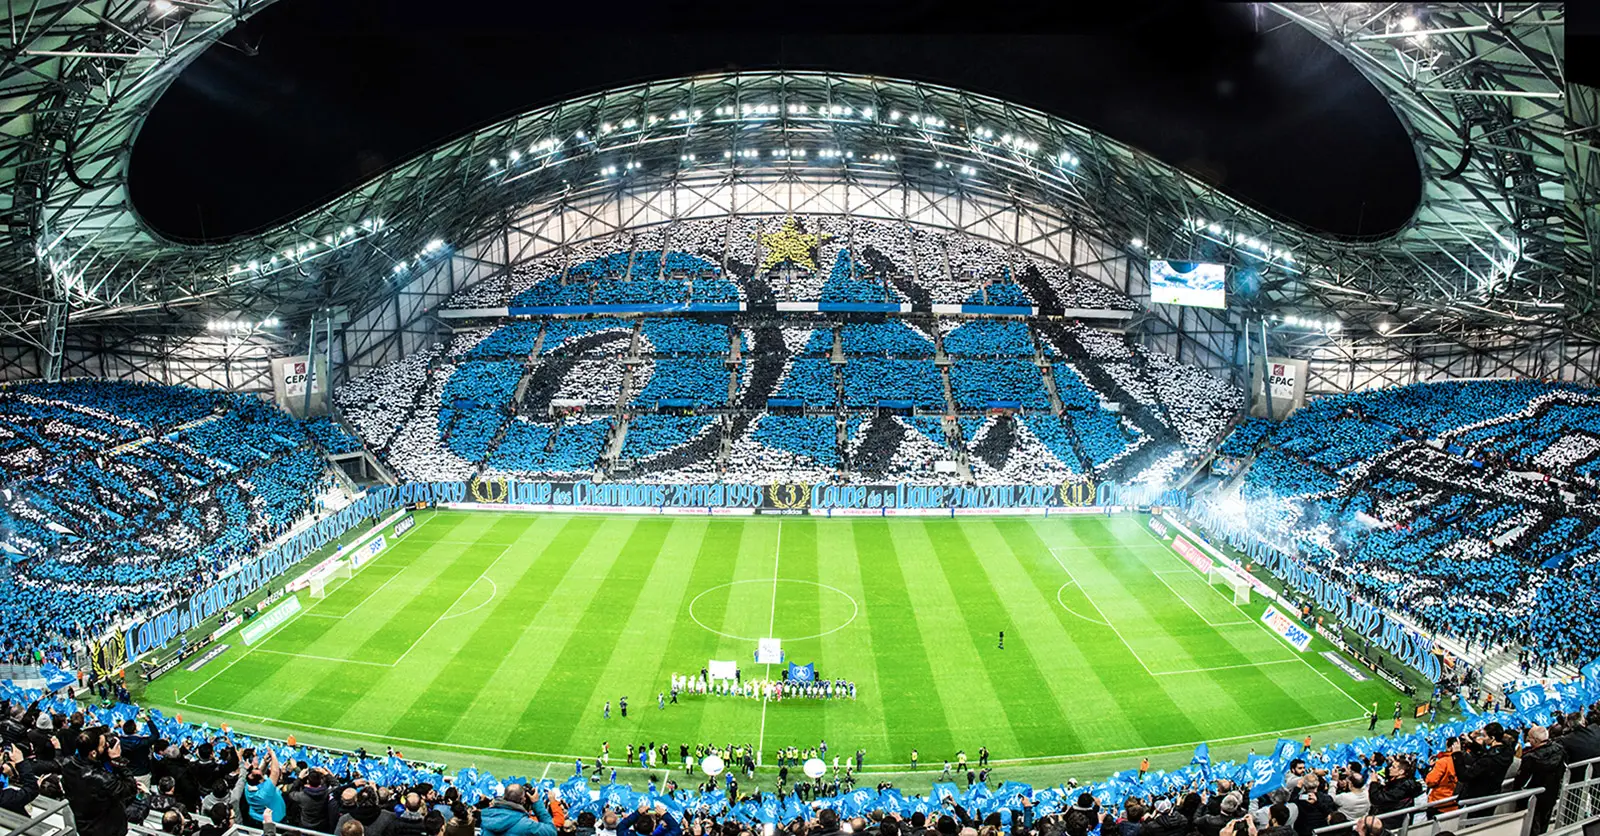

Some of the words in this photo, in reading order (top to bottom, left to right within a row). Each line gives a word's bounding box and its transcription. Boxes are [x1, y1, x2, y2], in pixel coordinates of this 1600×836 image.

[1262, 376, 1294, 387] EPAC
[507, 480, 552, 504] Ligue
[553, 487, 572, 505] des
[691, 480, 725, 507] mai
[725, 483, 764, 508] 1993
[785, 485, 796, 505] 3
[811, 481, 867, 509] Coupe
[867, 491, 881, 508] de
[883, 489, 895, 507] la
[125, 607, 178, 663] Coupe
